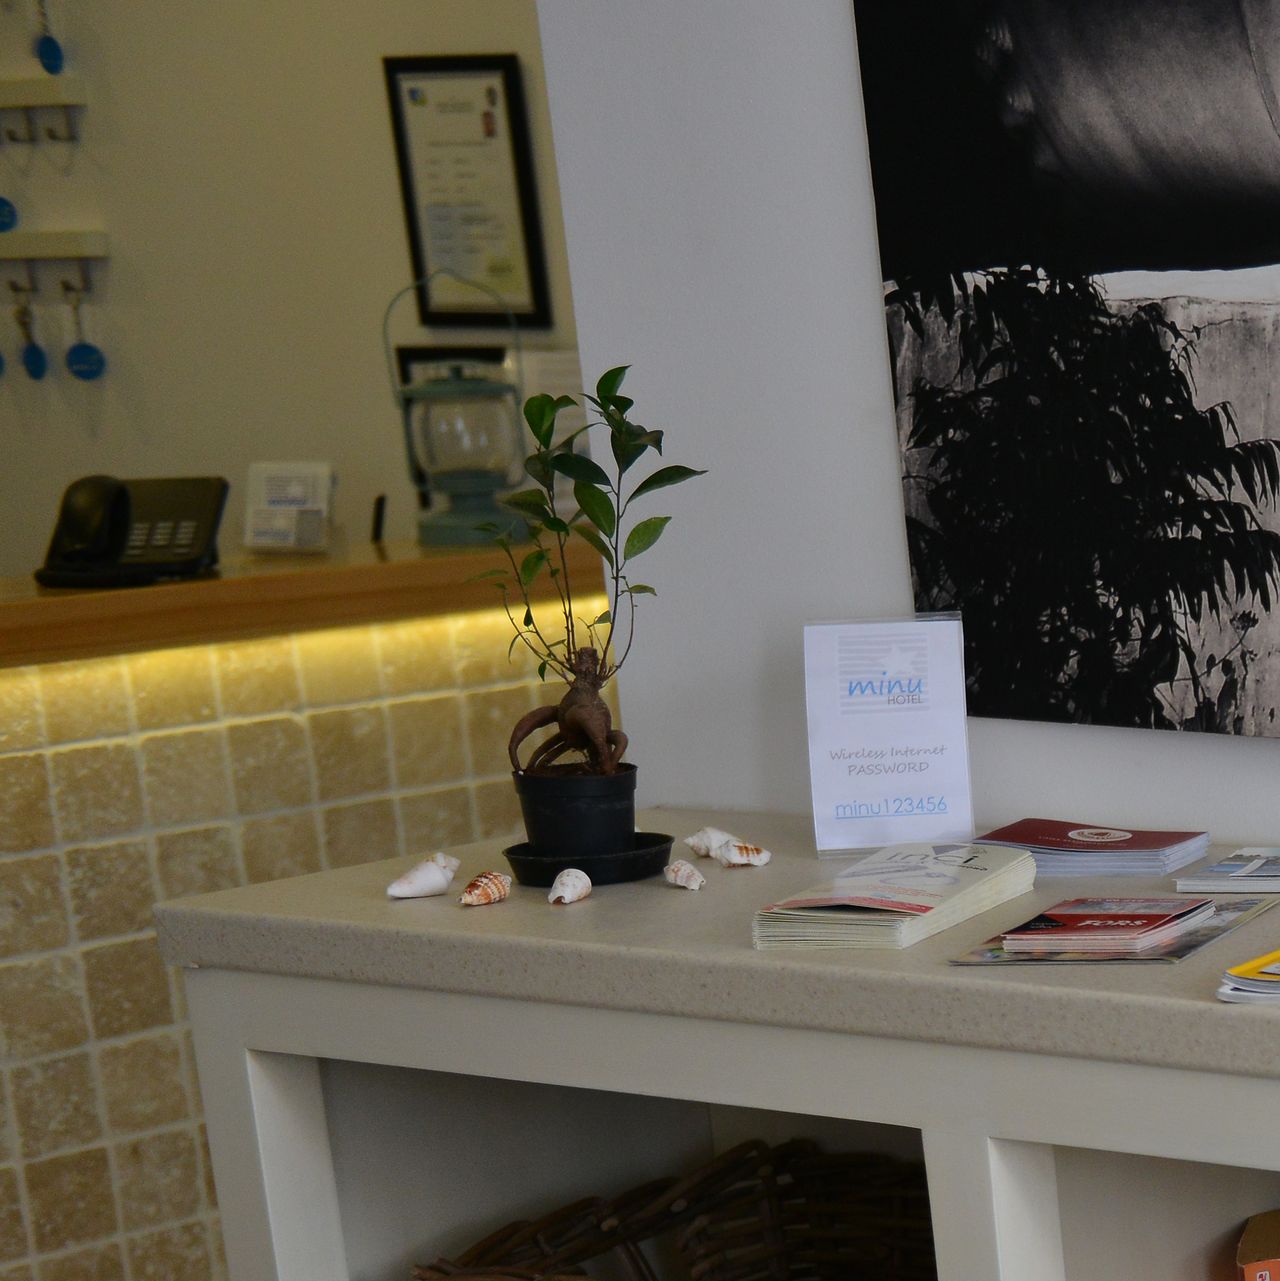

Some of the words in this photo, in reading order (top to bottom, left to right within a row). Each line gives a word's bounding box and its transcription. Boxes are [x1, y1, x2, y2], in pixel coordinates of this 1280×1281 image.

[848, 671, 924, 696] minu
[888, 695, 924, 705] HOTEL
[829, 748, 887, 760] Wireless
[891, 745, 947, 758] Internet
[848, 762, 929, 776] PASSWORD
[835, 796, 948, 817] minu123456
